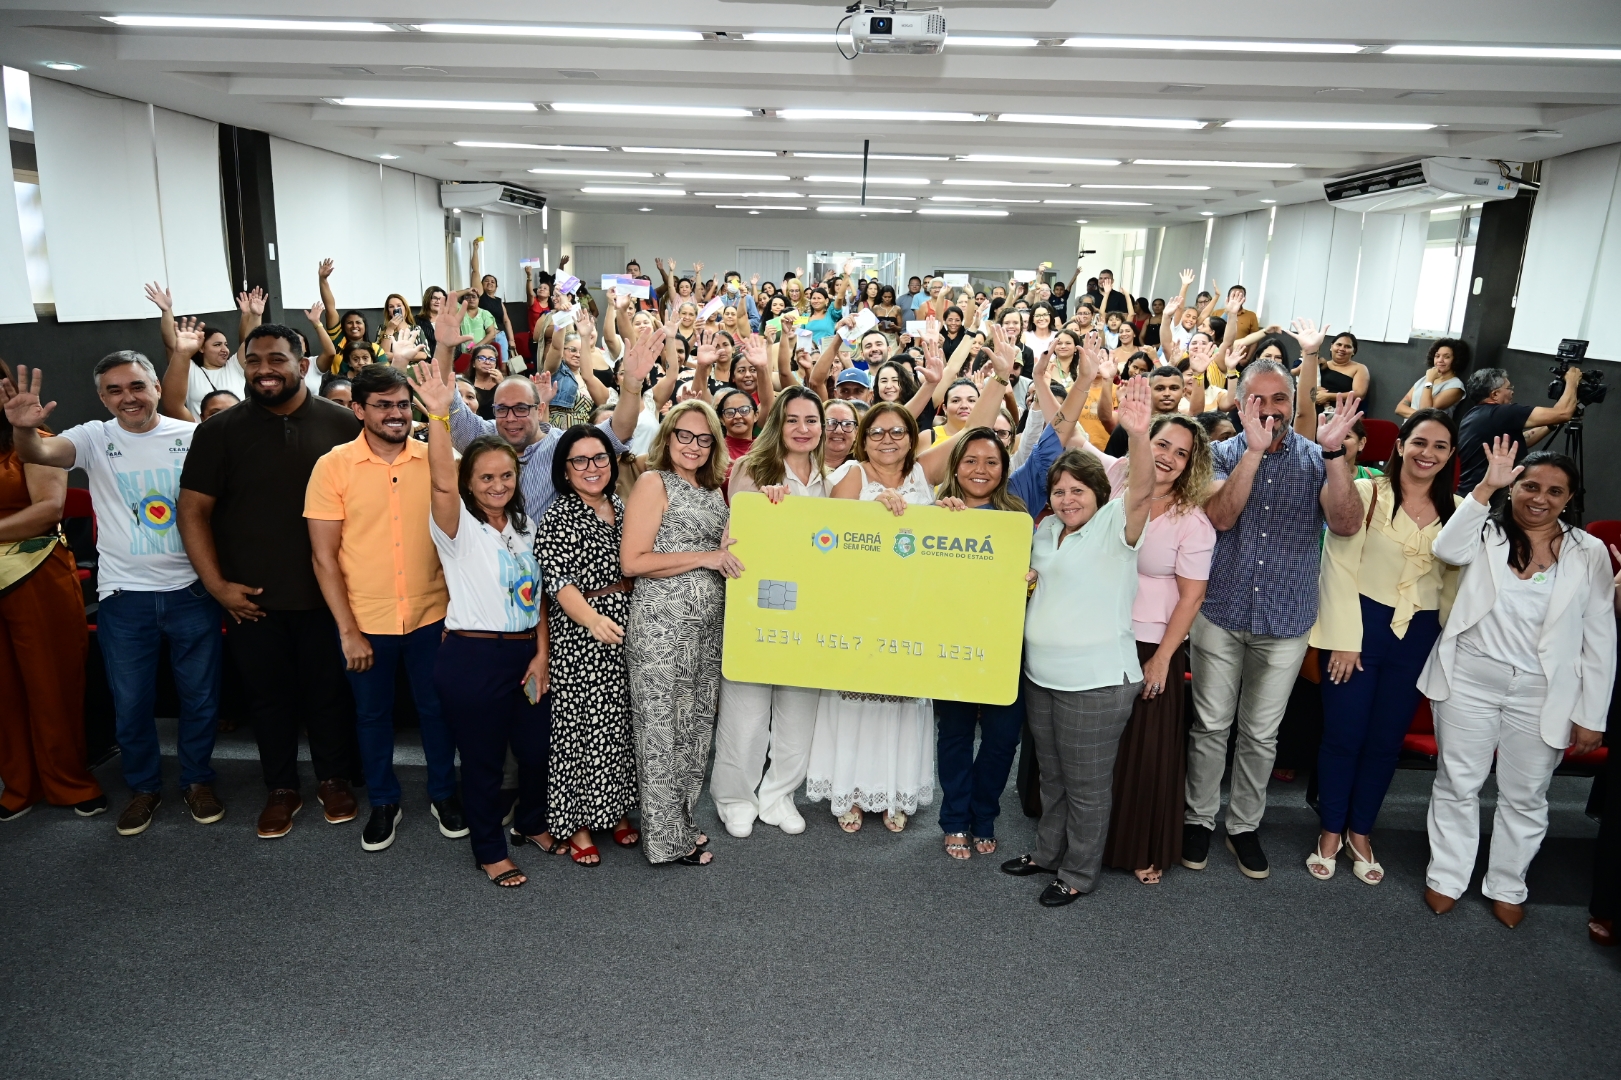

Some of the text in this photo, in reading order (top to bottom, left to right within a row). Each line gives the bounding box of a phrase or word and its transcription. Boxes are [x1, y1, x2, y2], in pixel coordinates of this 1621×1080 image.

[843, 532, 882, 544] CEARÁ
[922, 534, 994, 554] CEARÁ
[860, 544, 881, 552] FOME
[756, 628, 985, 661] 1234 4567 7890 1234
